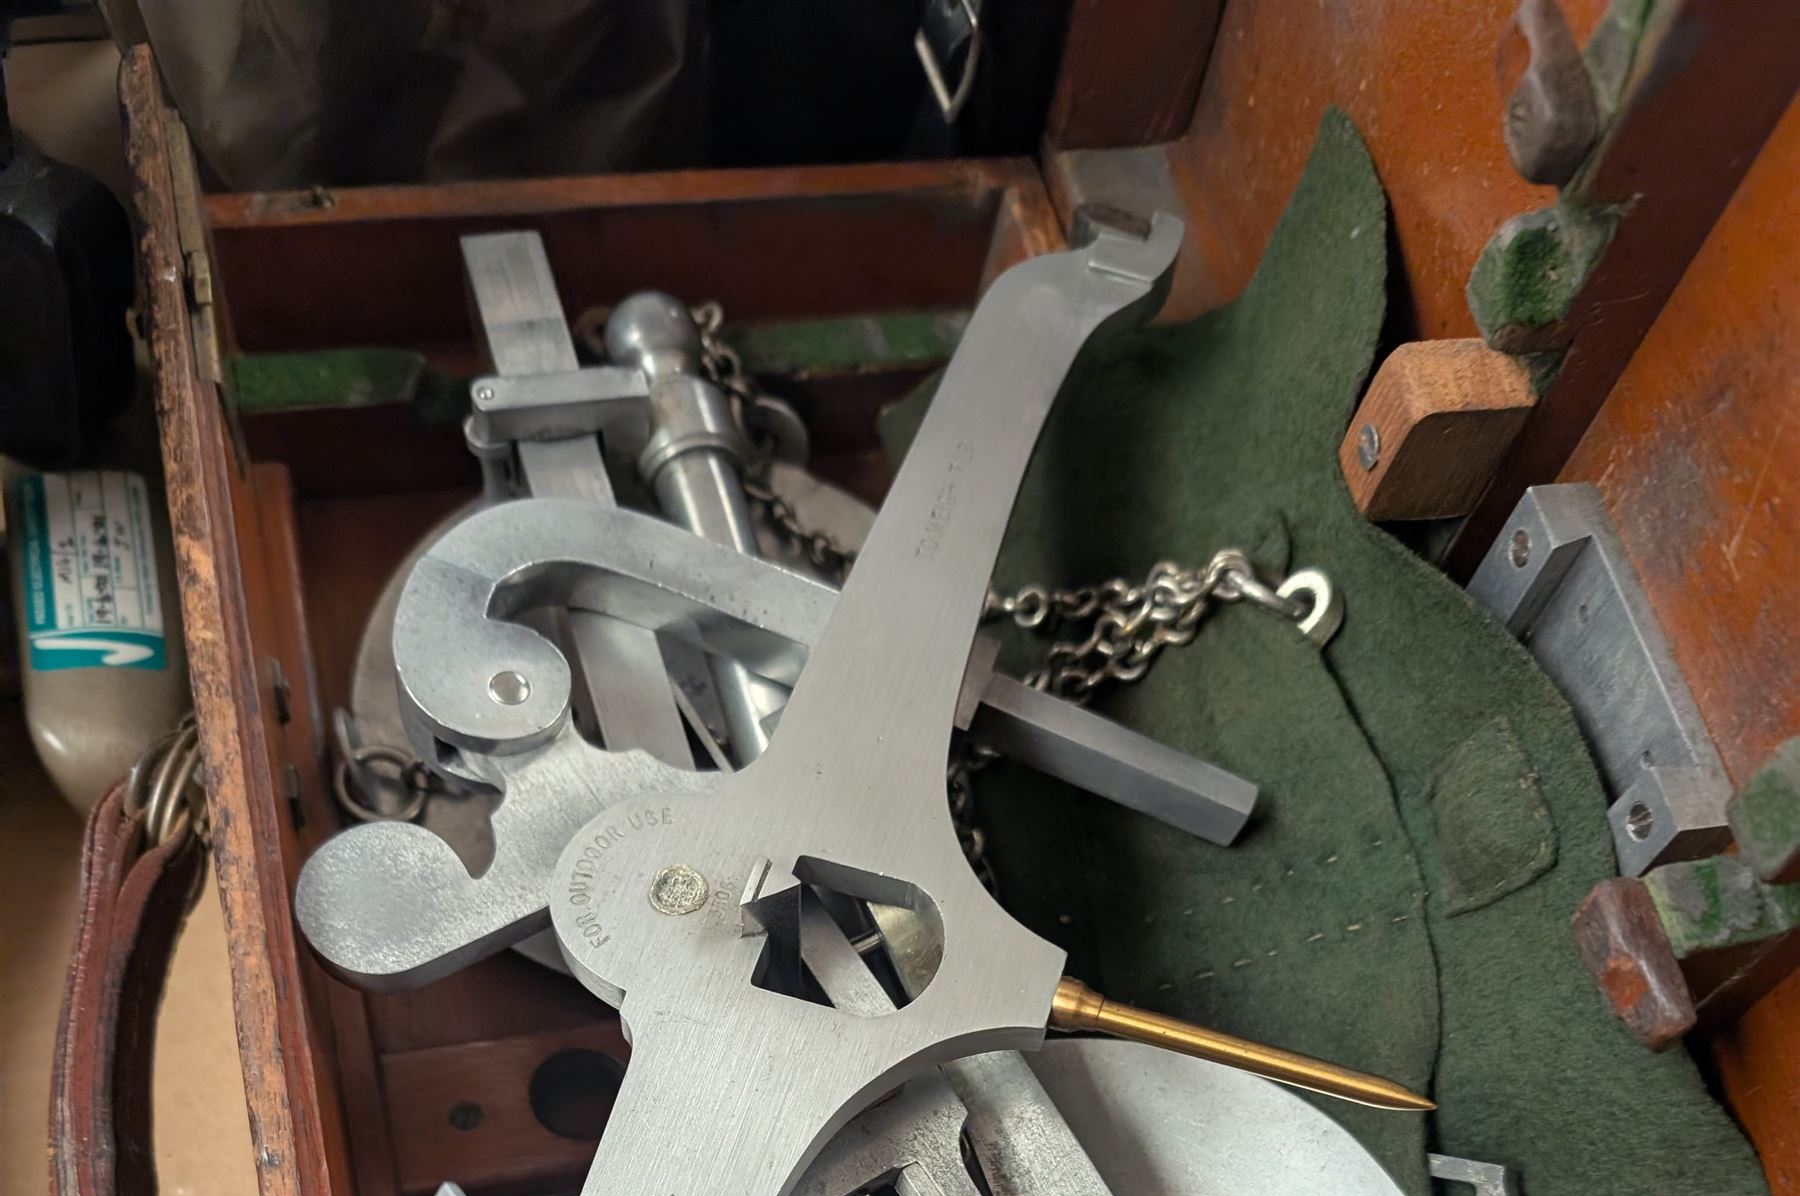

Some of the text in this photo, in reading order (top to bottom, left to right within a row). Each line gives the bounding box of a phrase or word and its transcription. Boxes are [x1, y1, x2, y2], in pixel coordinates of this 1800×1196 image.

[569, 806, 674, 949] FOR OUTDOOR USE
